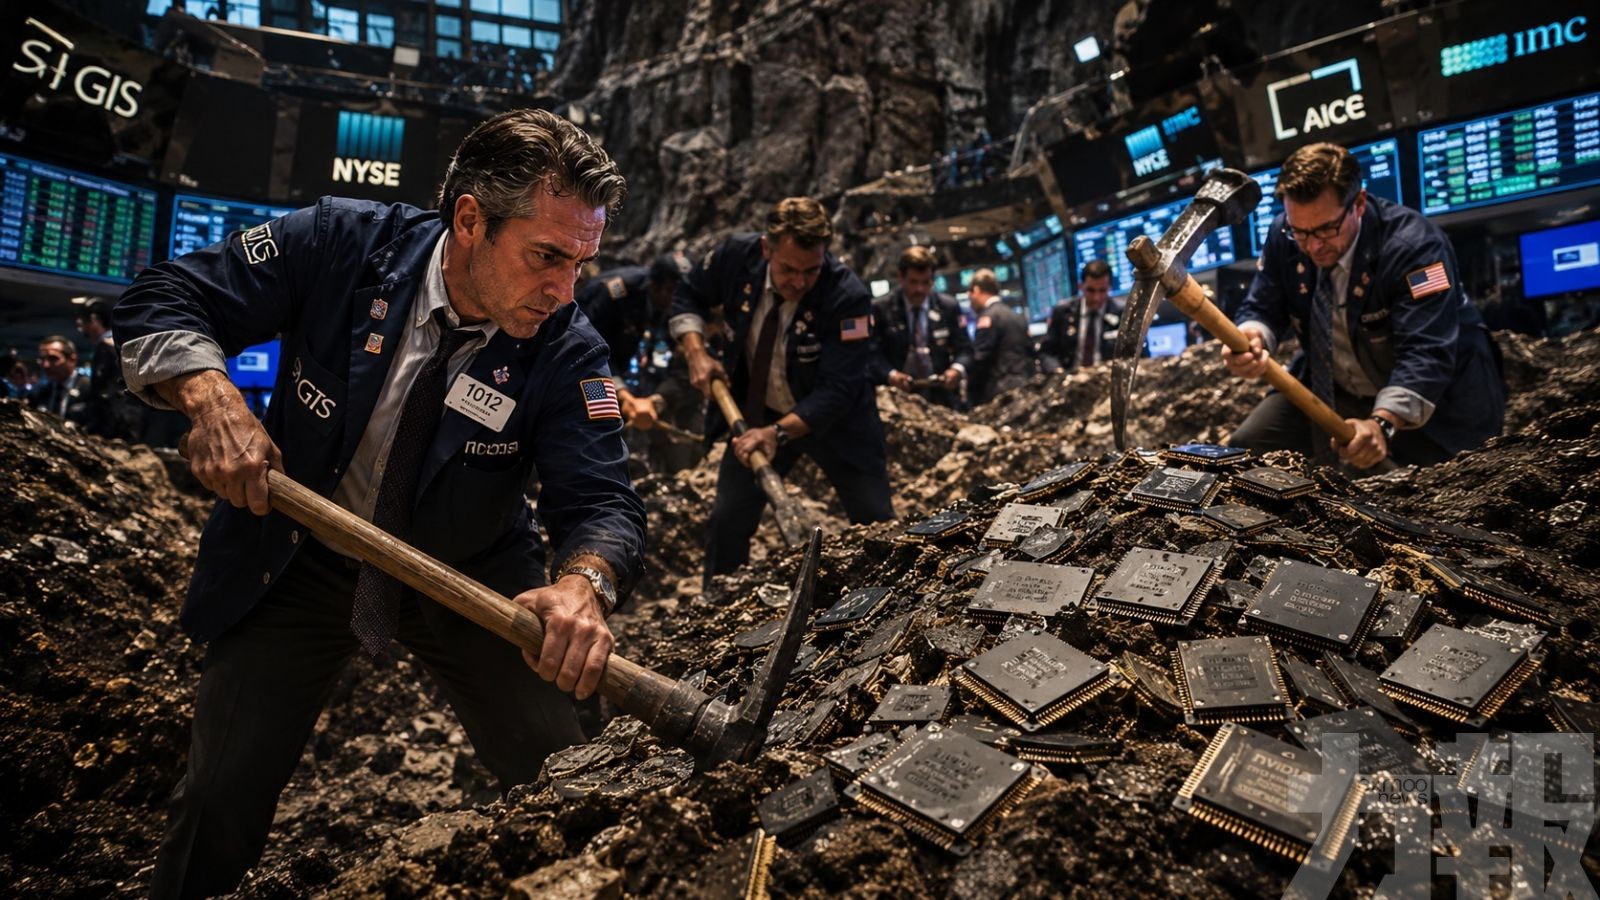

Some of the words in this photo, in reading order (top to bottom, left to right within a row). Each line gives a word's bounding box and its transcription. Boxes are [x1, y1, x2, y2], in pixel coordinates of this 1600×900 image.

[1302, 93, 1367, 133] AICE
[332, 156, 401, 188] NYSE
[466, 383, 503, 412] 1012
